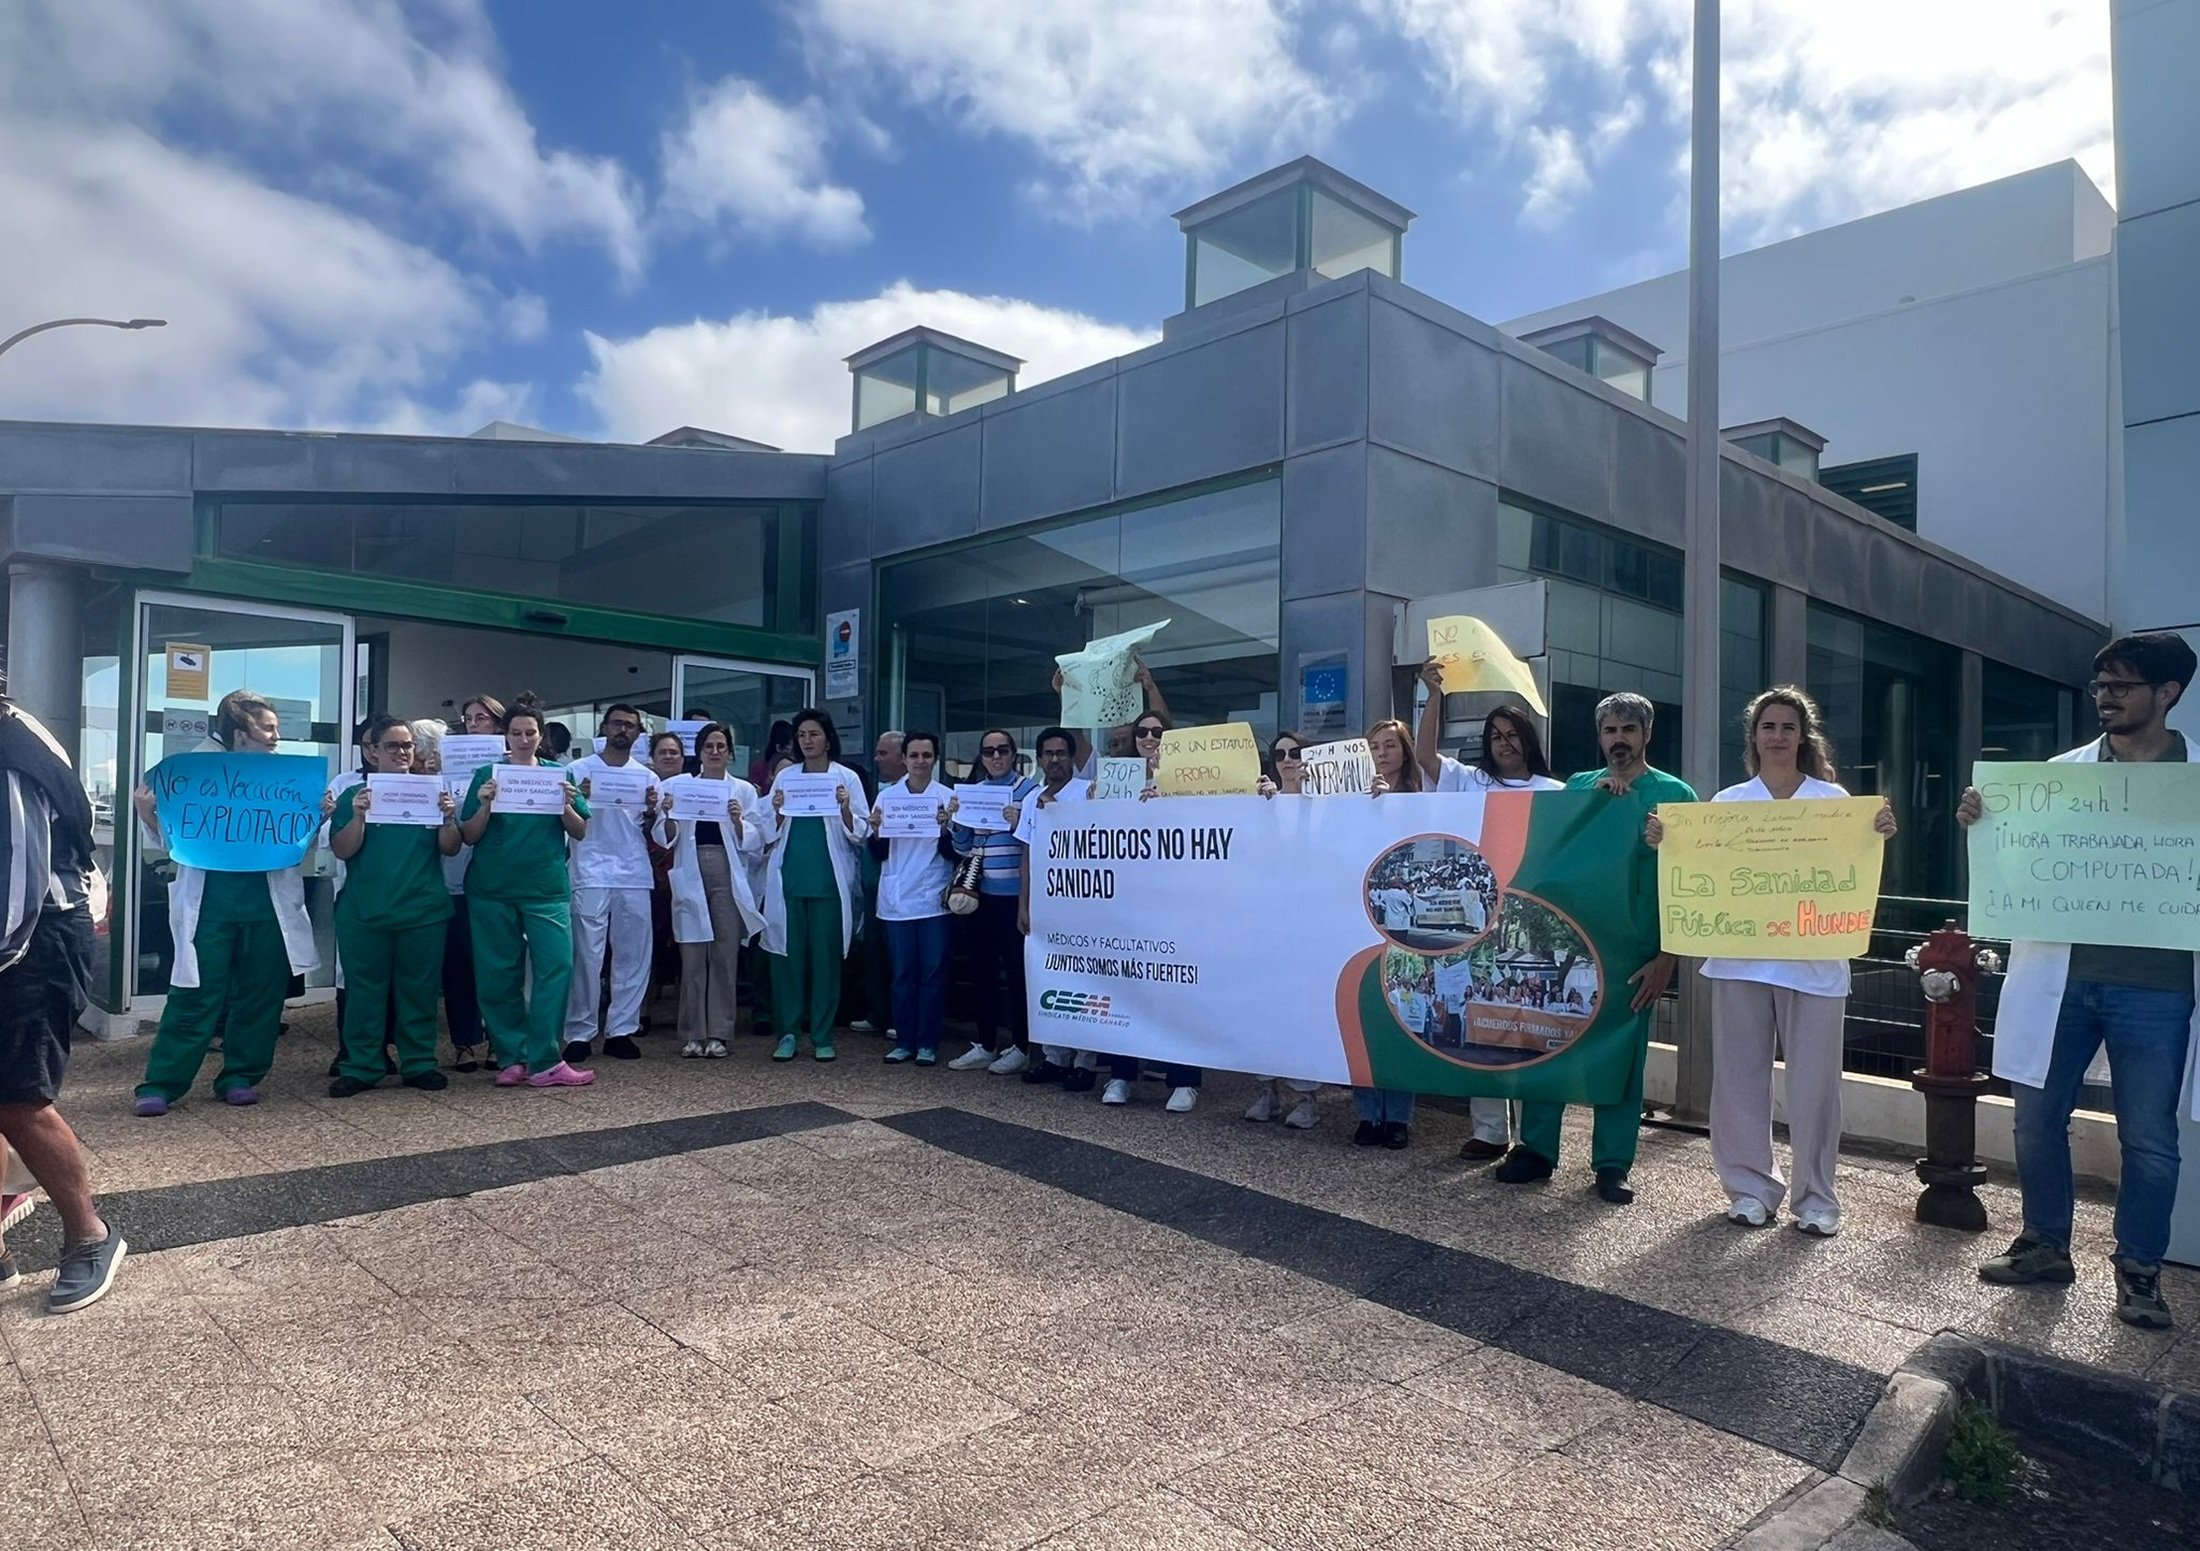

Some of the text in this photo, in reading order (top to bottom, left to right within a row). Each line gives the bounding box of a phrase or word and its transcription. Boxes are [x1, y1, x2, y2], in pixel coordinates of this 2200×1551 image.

[1161, 738, 1255, 756] POR UN ESTATUTO
[1344, 742, 1366, 753] NOS
[152, 766, 190, 802] No
[200, 777, 219, 798] es
[1102, 762, 1141, 781] STOP
[1174, 765, 1221, 783] PROPIO
[1980, 780, 2064, 814] STOP
[2068, 784, 2110, 812] 24h
[1048, 823, 1234, 861] SIN MÉDICOS NO HAY
[2153, 834, 2194, 848] HORA
[1046, 867, 1115, 900] SANIDAD
[1671, 864, 1856, 898] La Sanidad
[2121, 899, 2146, 914] ME
[1666, 904, 1757, 938] Pública
[1047, 932, 1176, 954] MÉDICOS Y FACULTATIVOS
[1045, 953, 1198, 985] ¡JUNTOS SOMOS MÁS FUERTES!
